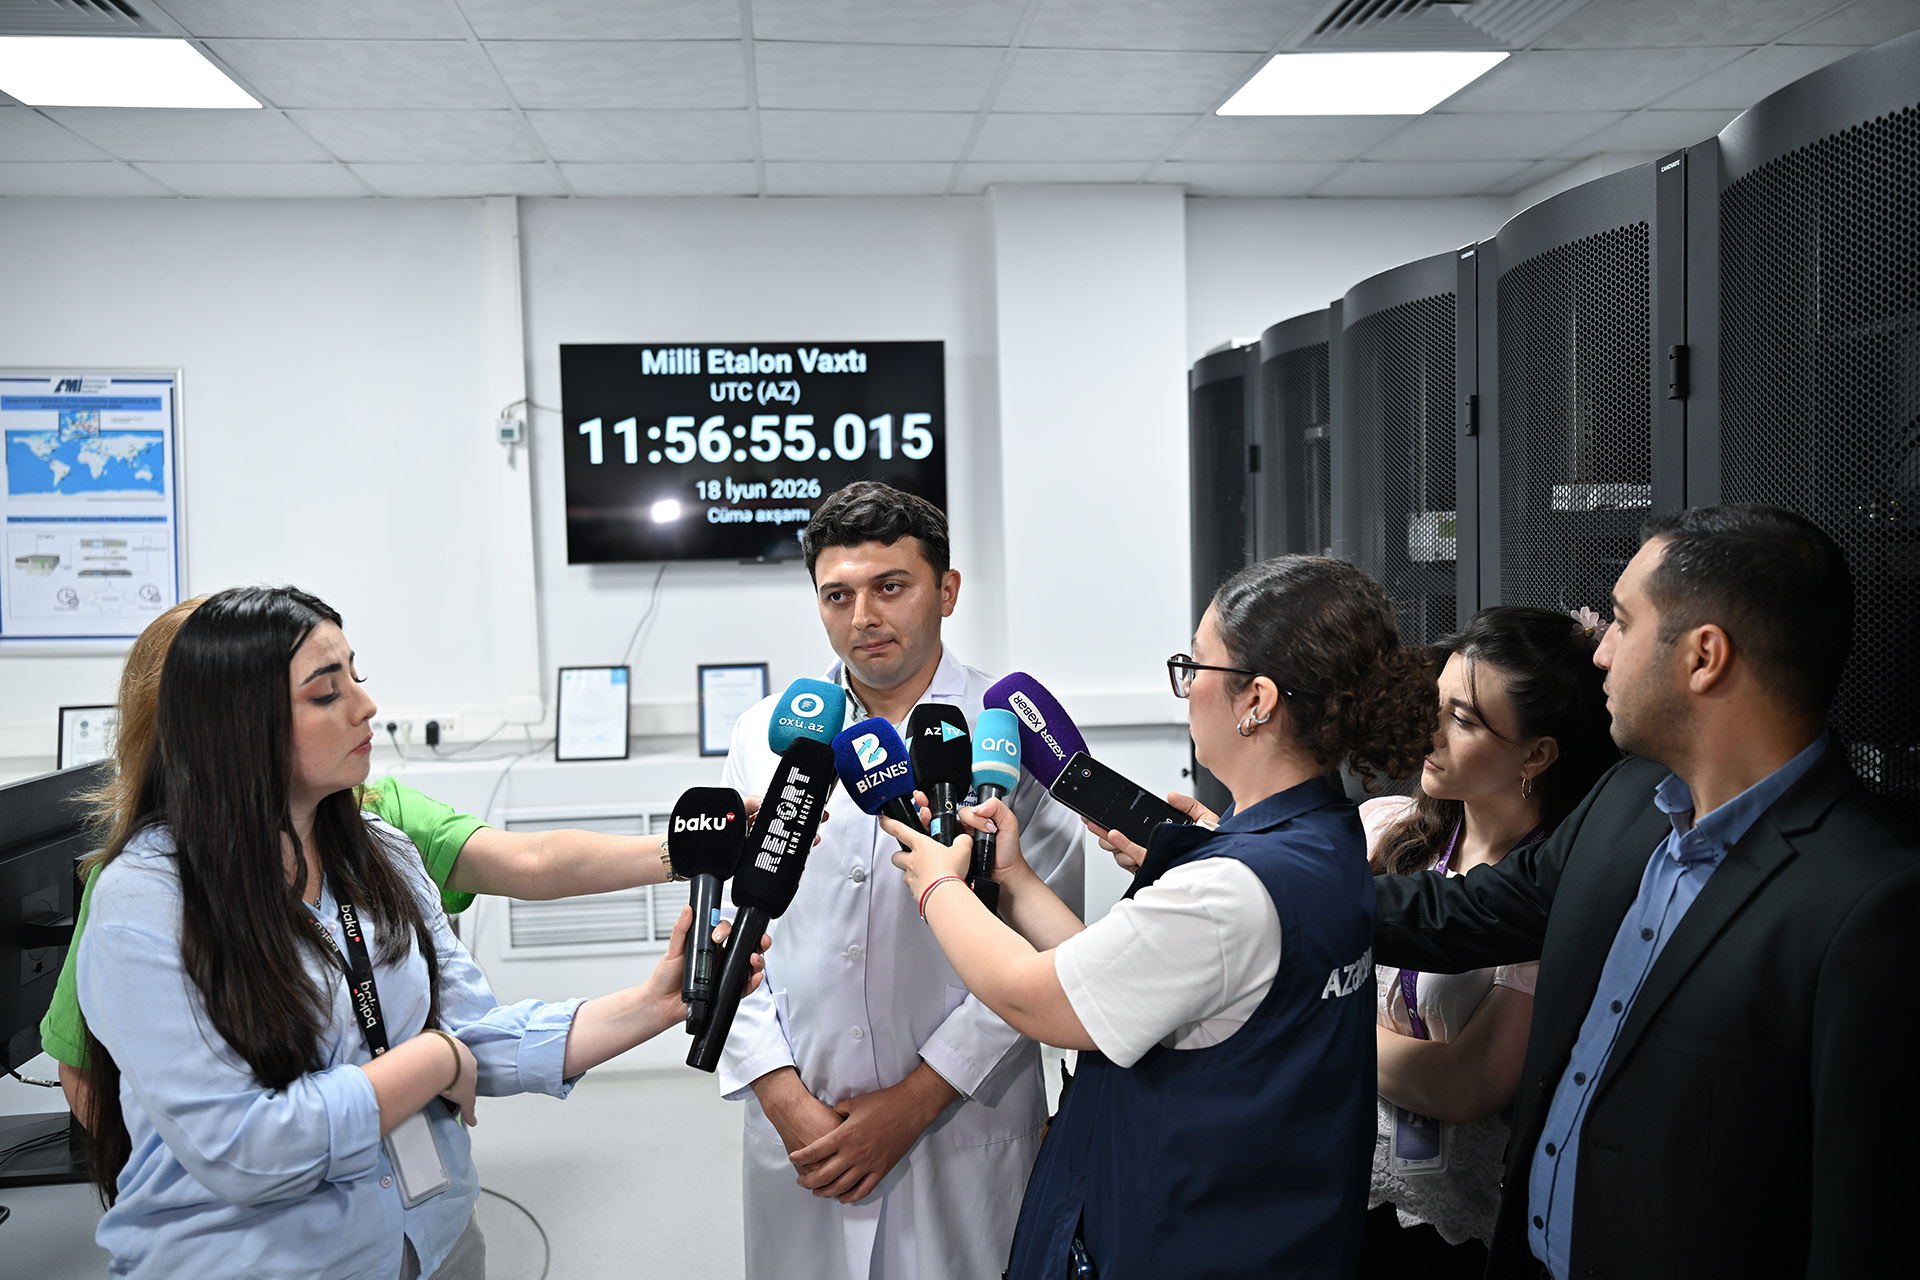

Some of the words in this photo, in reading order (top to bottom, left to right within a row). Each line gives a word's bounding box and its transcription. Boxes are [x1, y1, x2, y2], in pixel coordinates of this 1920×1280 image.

[641, 348, 701, 375] Milli
[707, 347, 793, 374] Etalon
[797, 347, 867, 374] Vaxtı
[710, 381, 753, 402] UTC
[757, 379, 801, 406] (AZ)
[578, 412, 934, 465] 11:56:55.015
[696, 480, 722, 500] 18
[770, 478, 822, 499] 2026
[707, 506, 754, 524] Cümə
[755, 508, 811, 525] axşamı
[778, 717, 825, 733] oxu.az
[981, 737, 1017, 756] arb
[674, 813, 727, 834] baku
[754, 766, 811, 874] REPORT
[787, 831, 802, 855] NEWS
[797, 793, 815, 826] AGENCY
[340, 904, 357, 937] baku
[314, 921, 339, 953] baku
[356, 993, 377, 1029] baku
